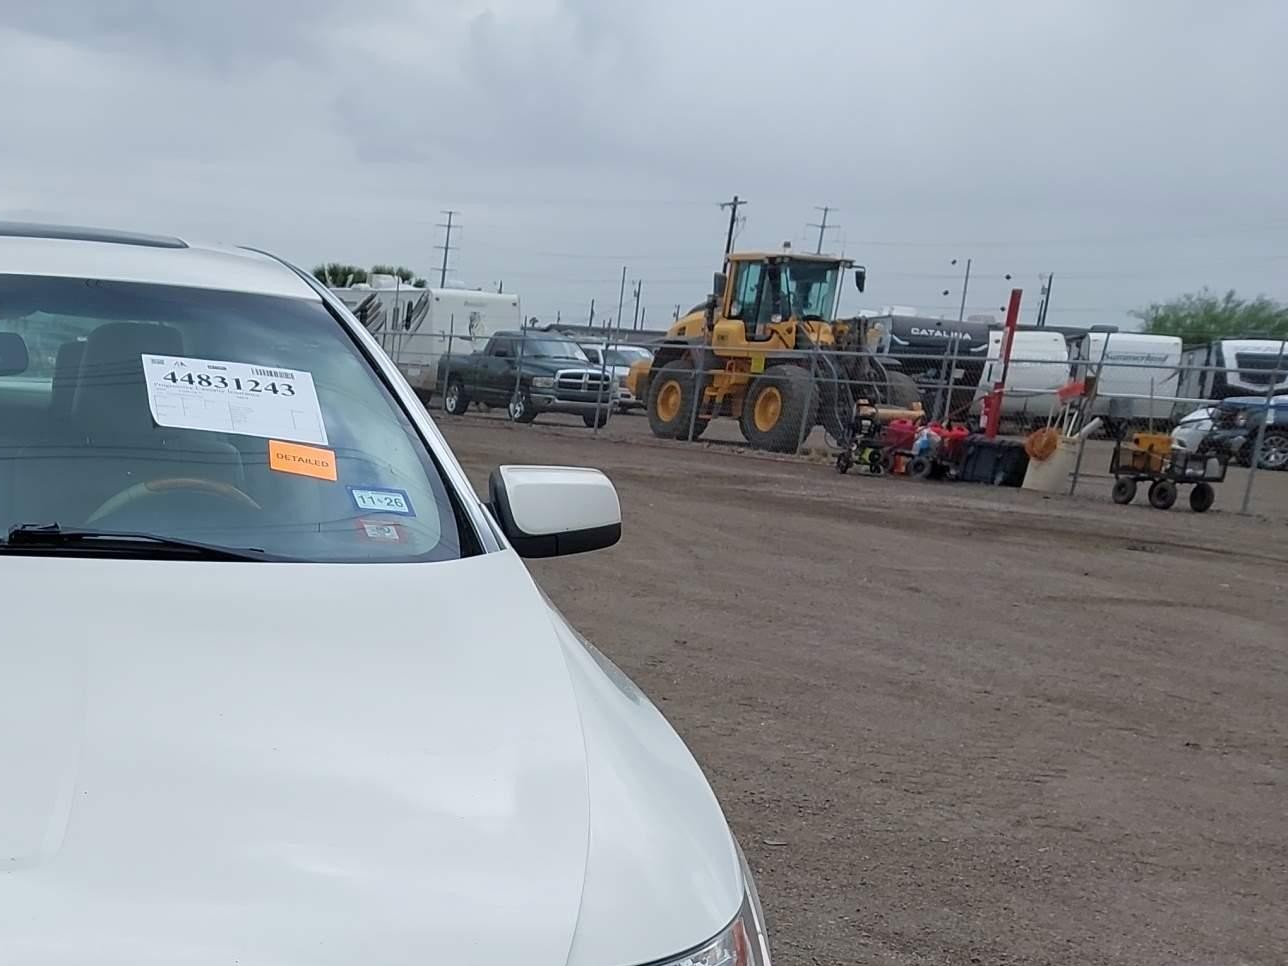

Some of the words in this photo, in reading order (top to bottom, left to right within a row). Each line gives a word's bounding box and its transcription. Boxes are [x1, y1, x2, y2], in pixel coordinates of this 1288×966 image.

[910, 327, 972, 341] CATALINA
[163, 371, 296, 397] 44831243
[276, 452, 329, 468] DETAILED
